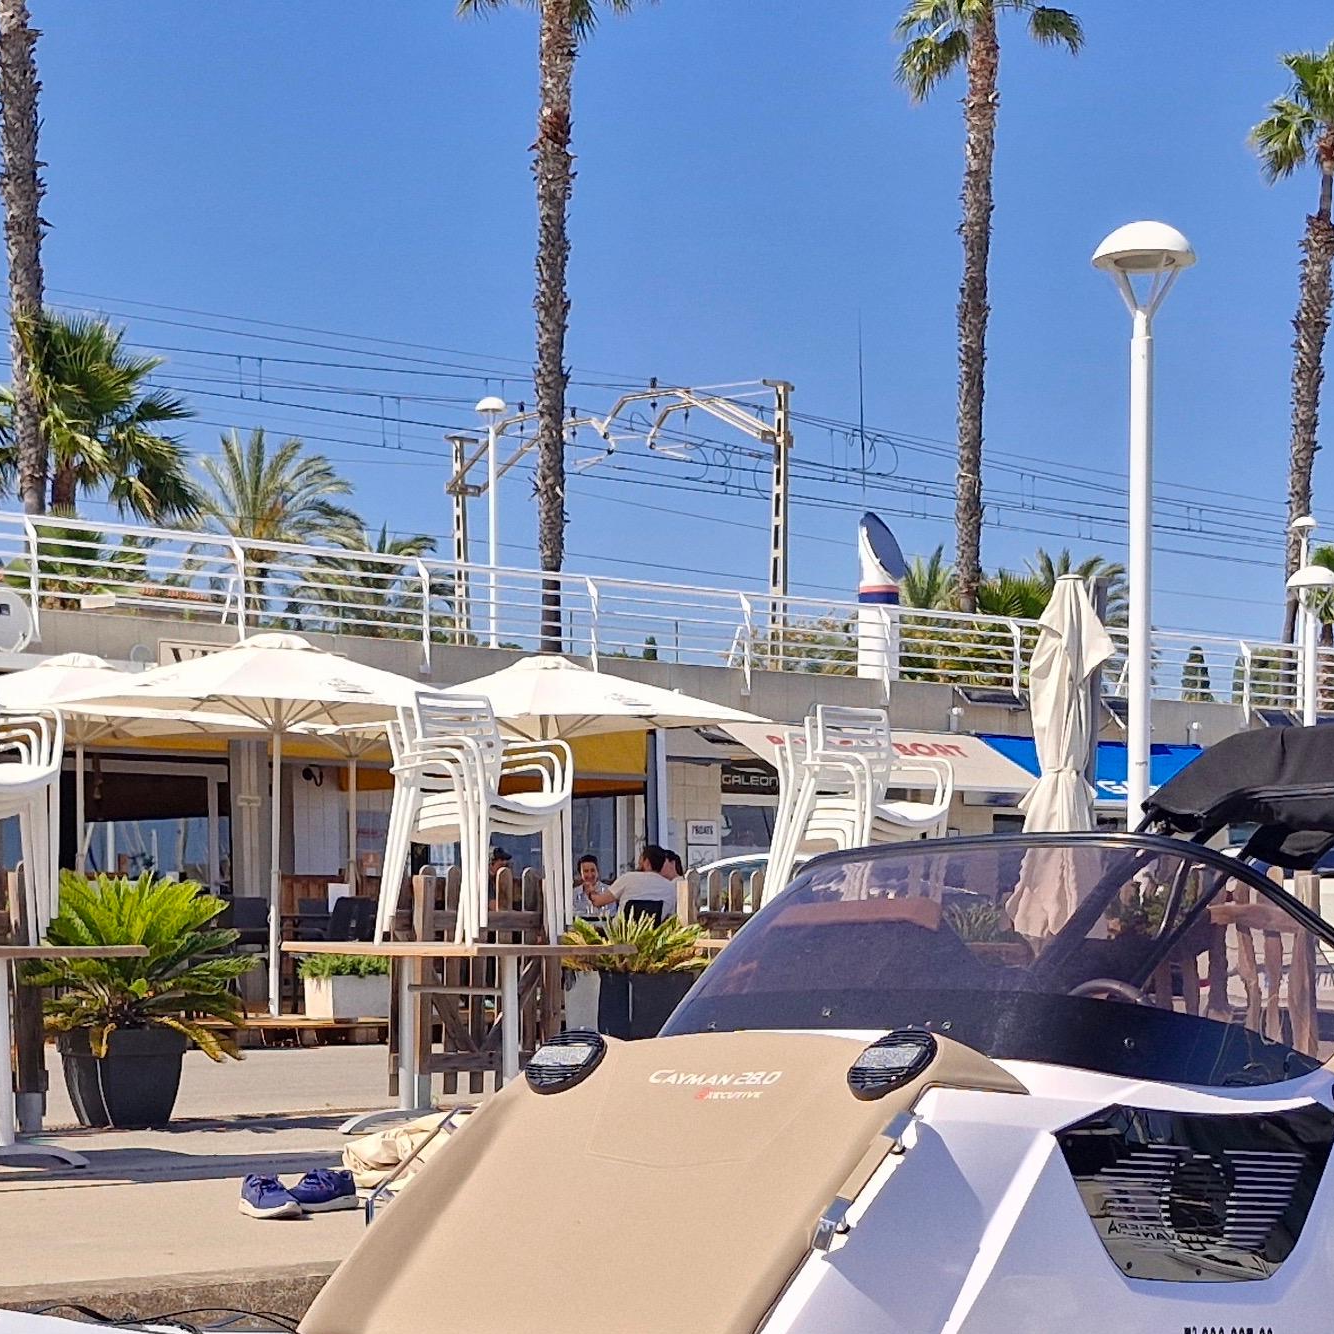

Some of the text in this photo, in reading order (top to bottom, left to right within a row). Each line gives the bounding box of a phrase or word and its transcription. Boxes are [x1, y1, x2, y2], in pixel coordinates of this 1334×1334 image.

[722, 774, 779, 787] GALEON
[648, 1069, 735, 1086] CAYMAN
[693, 1086, 764, 1101] EXECUTIVE
